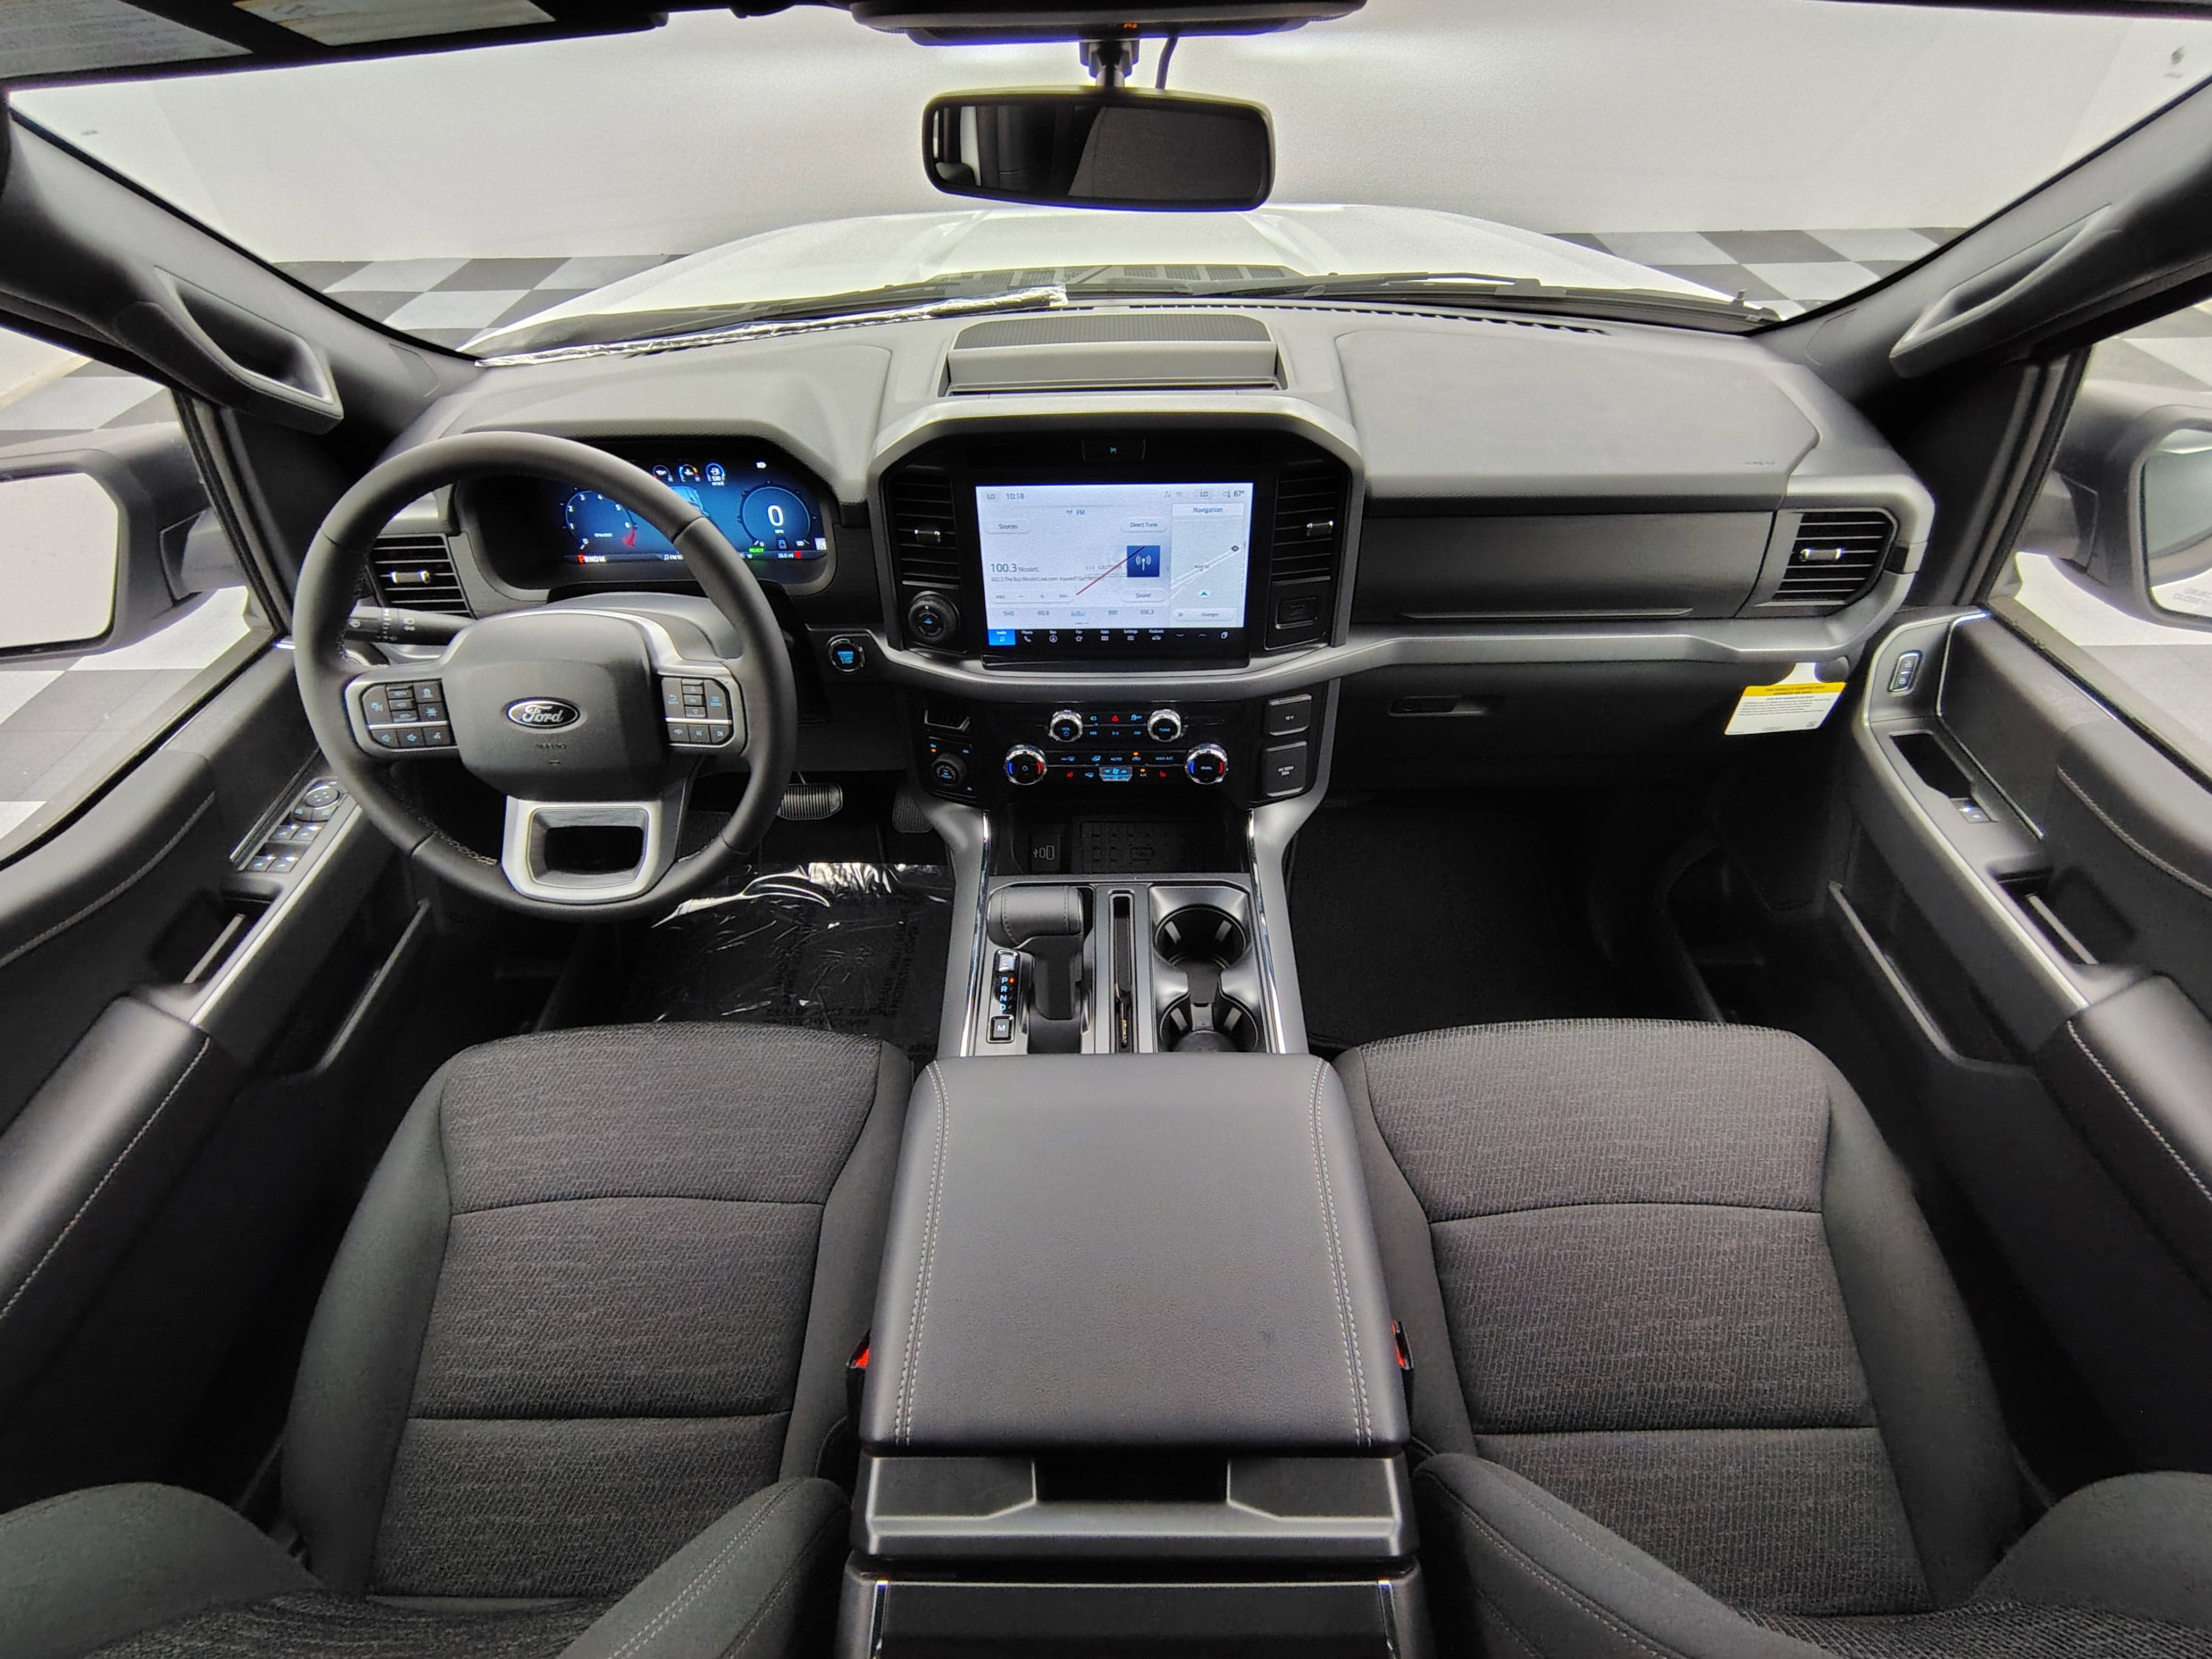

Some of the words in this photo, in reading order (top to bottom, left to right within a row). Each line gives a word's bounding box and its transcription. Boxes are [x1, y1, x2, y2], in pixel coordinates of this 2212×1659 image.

[768, 505, 784, 526] 0
[990, 563, 1017, 573] 100.3
[522, 705, 564, 723] Ford
